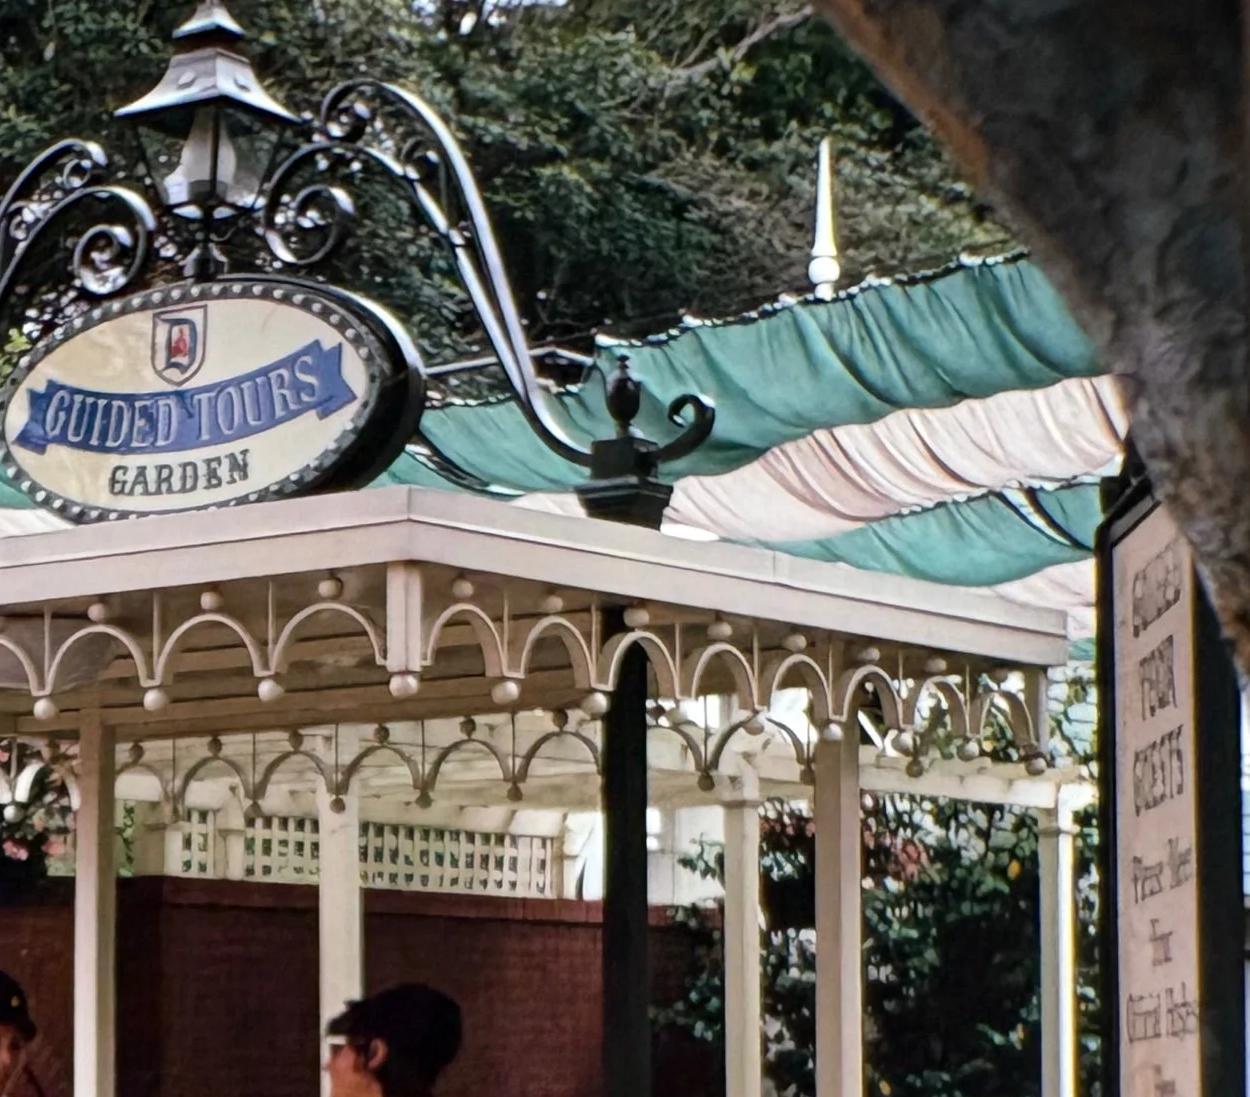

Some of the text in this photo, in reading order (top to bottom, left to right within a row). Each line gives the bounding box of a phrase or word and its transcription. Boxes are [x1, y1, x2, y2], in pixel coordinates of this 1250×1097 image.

[47, 354, 321, 449] GUIDED TOURS
[108, 449, 251, 497] GARDEN
